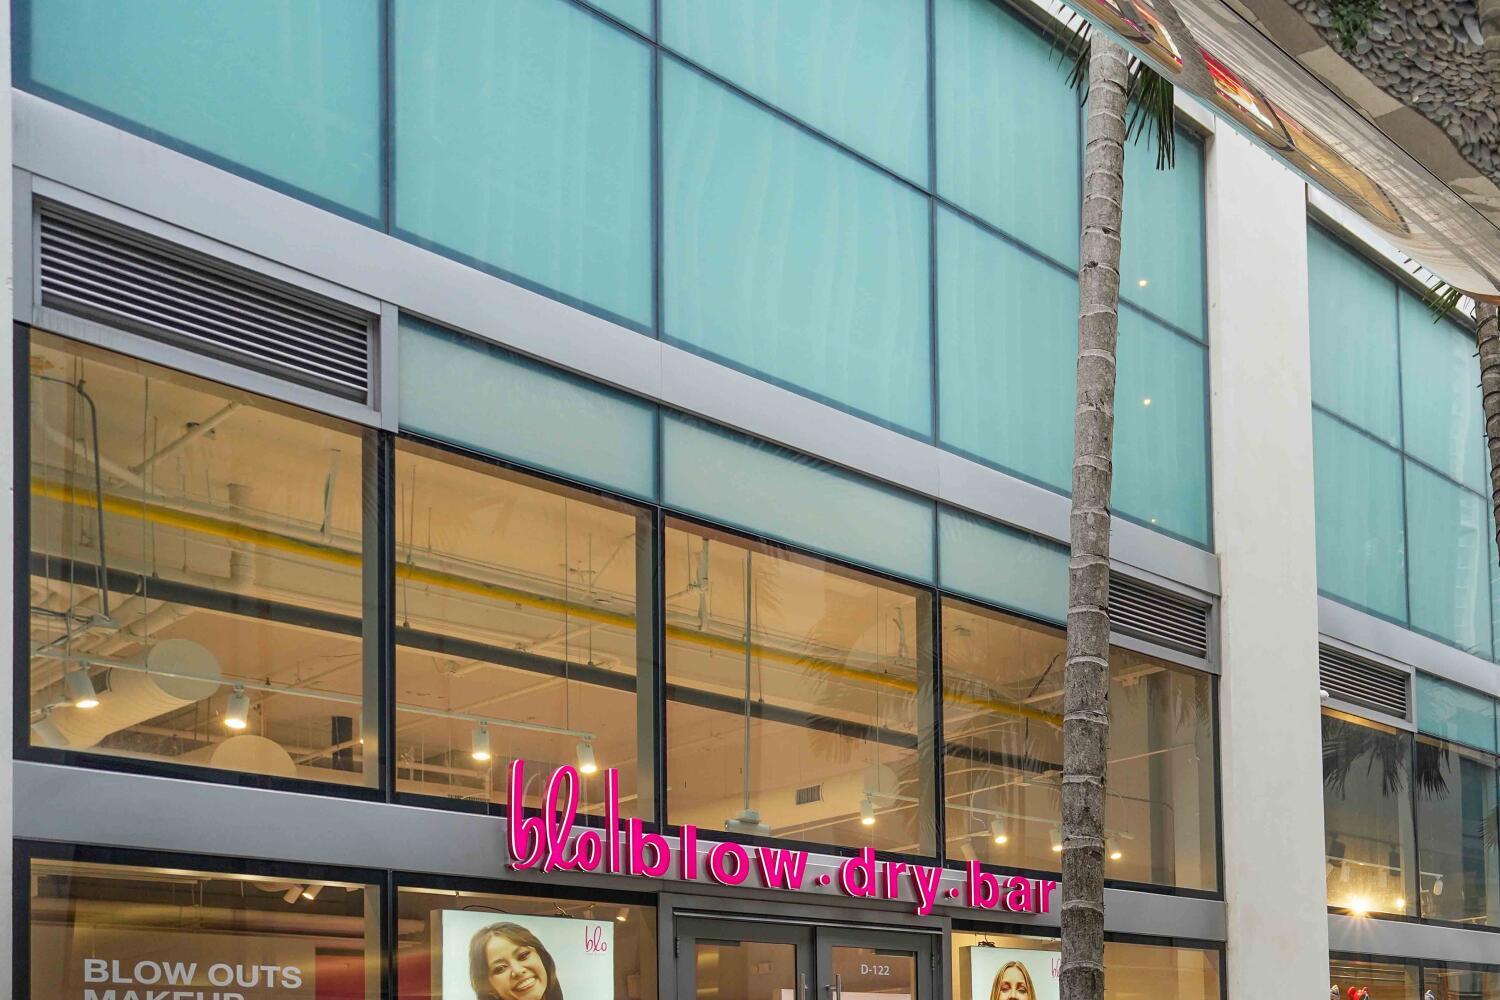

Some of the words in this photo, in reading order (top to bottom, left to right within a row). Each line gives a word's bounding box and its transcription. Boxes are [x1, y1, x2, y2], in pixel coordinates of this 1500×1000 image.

[506, 758, 602, 873] blo
[84, 959, 197, 986] BLOW
[208, 963, 302, 988] OUTS
[861, 964, 890, 976] D-122
